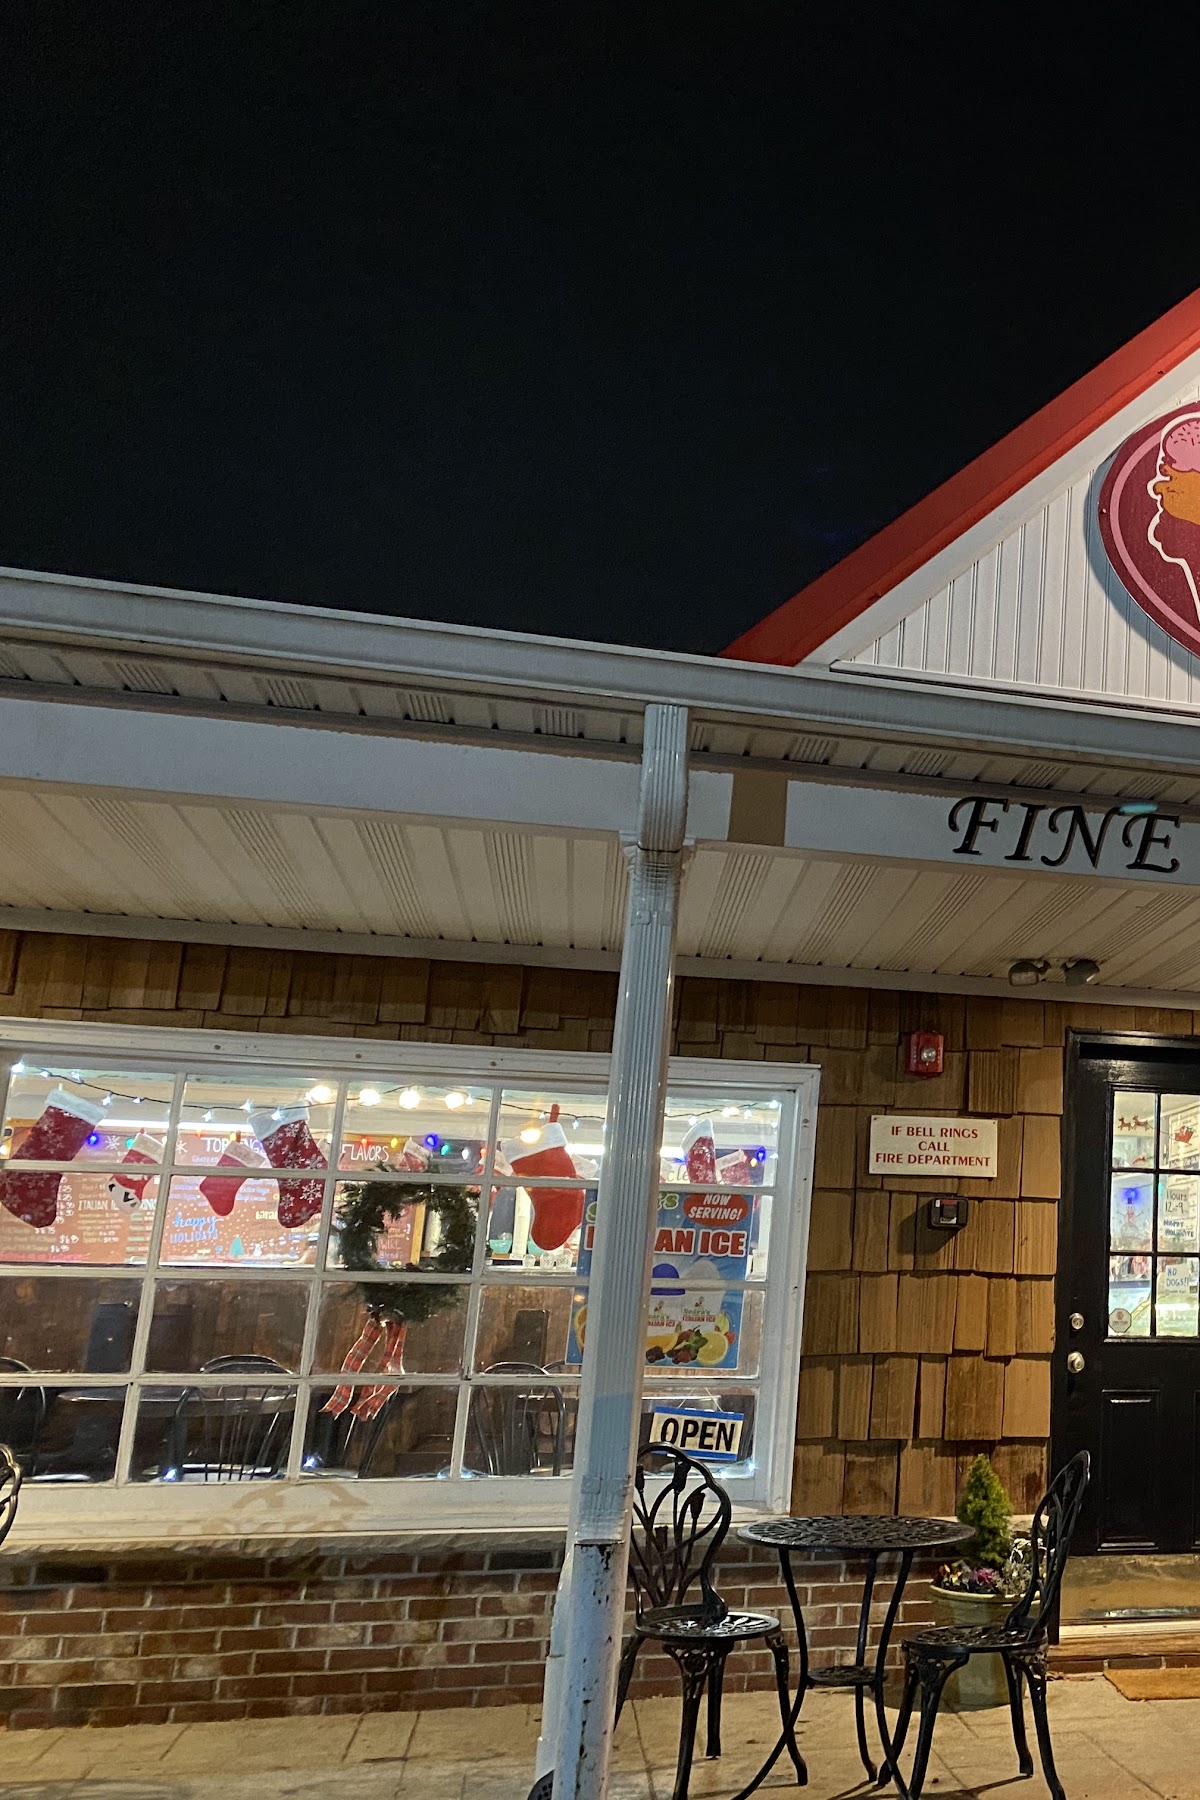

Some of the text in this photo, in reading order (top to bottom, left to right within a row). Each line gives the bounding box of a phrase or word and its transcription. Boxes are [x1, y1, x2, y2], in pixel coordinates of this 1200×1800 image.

[948, 795, 1181, 873] FINE
[891, 1126, 978, 1139] IF BELL RINGS
[341, 1143, 390, 1162] FLAVORS
[918, 1141, 950, 1152] CALL
[875, 1152, 991, 1167] FIRE DEPARTMENT
[703, 1194, 732, 1206] NOW
[688, 1206, 743, 1221] SERVING!
[172, 1212, 224, 1234] happy
[699, 1230, 747, 1256] ICE
[660, 1417, 736, 1452] OPEN
